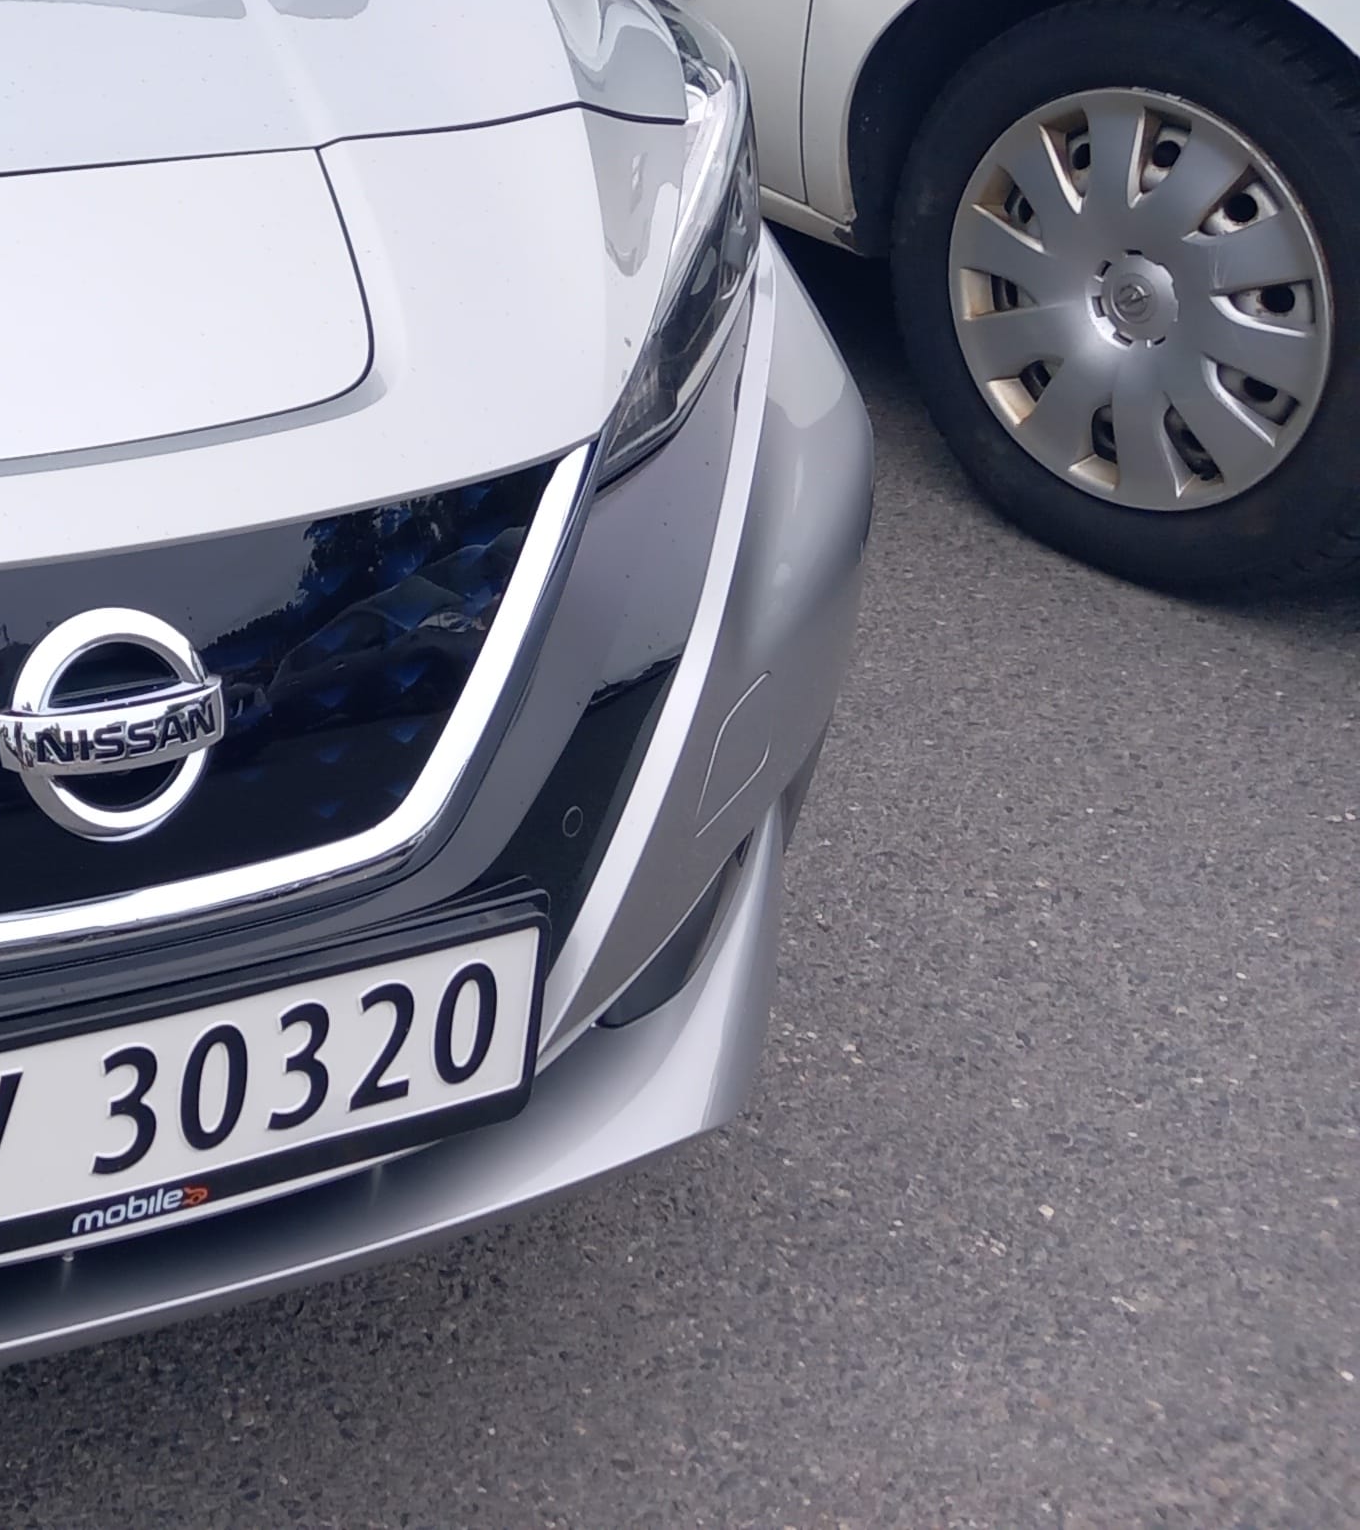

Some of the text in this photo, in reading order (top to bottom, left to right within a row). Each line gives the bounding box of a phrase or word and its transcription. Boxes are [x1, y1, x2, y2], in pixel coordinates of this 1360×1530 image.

[34, 698, 218, 765] NISSAN
[90, 960, 499, 1175] 30320
[71, 1187, 183, 1234] mobile
